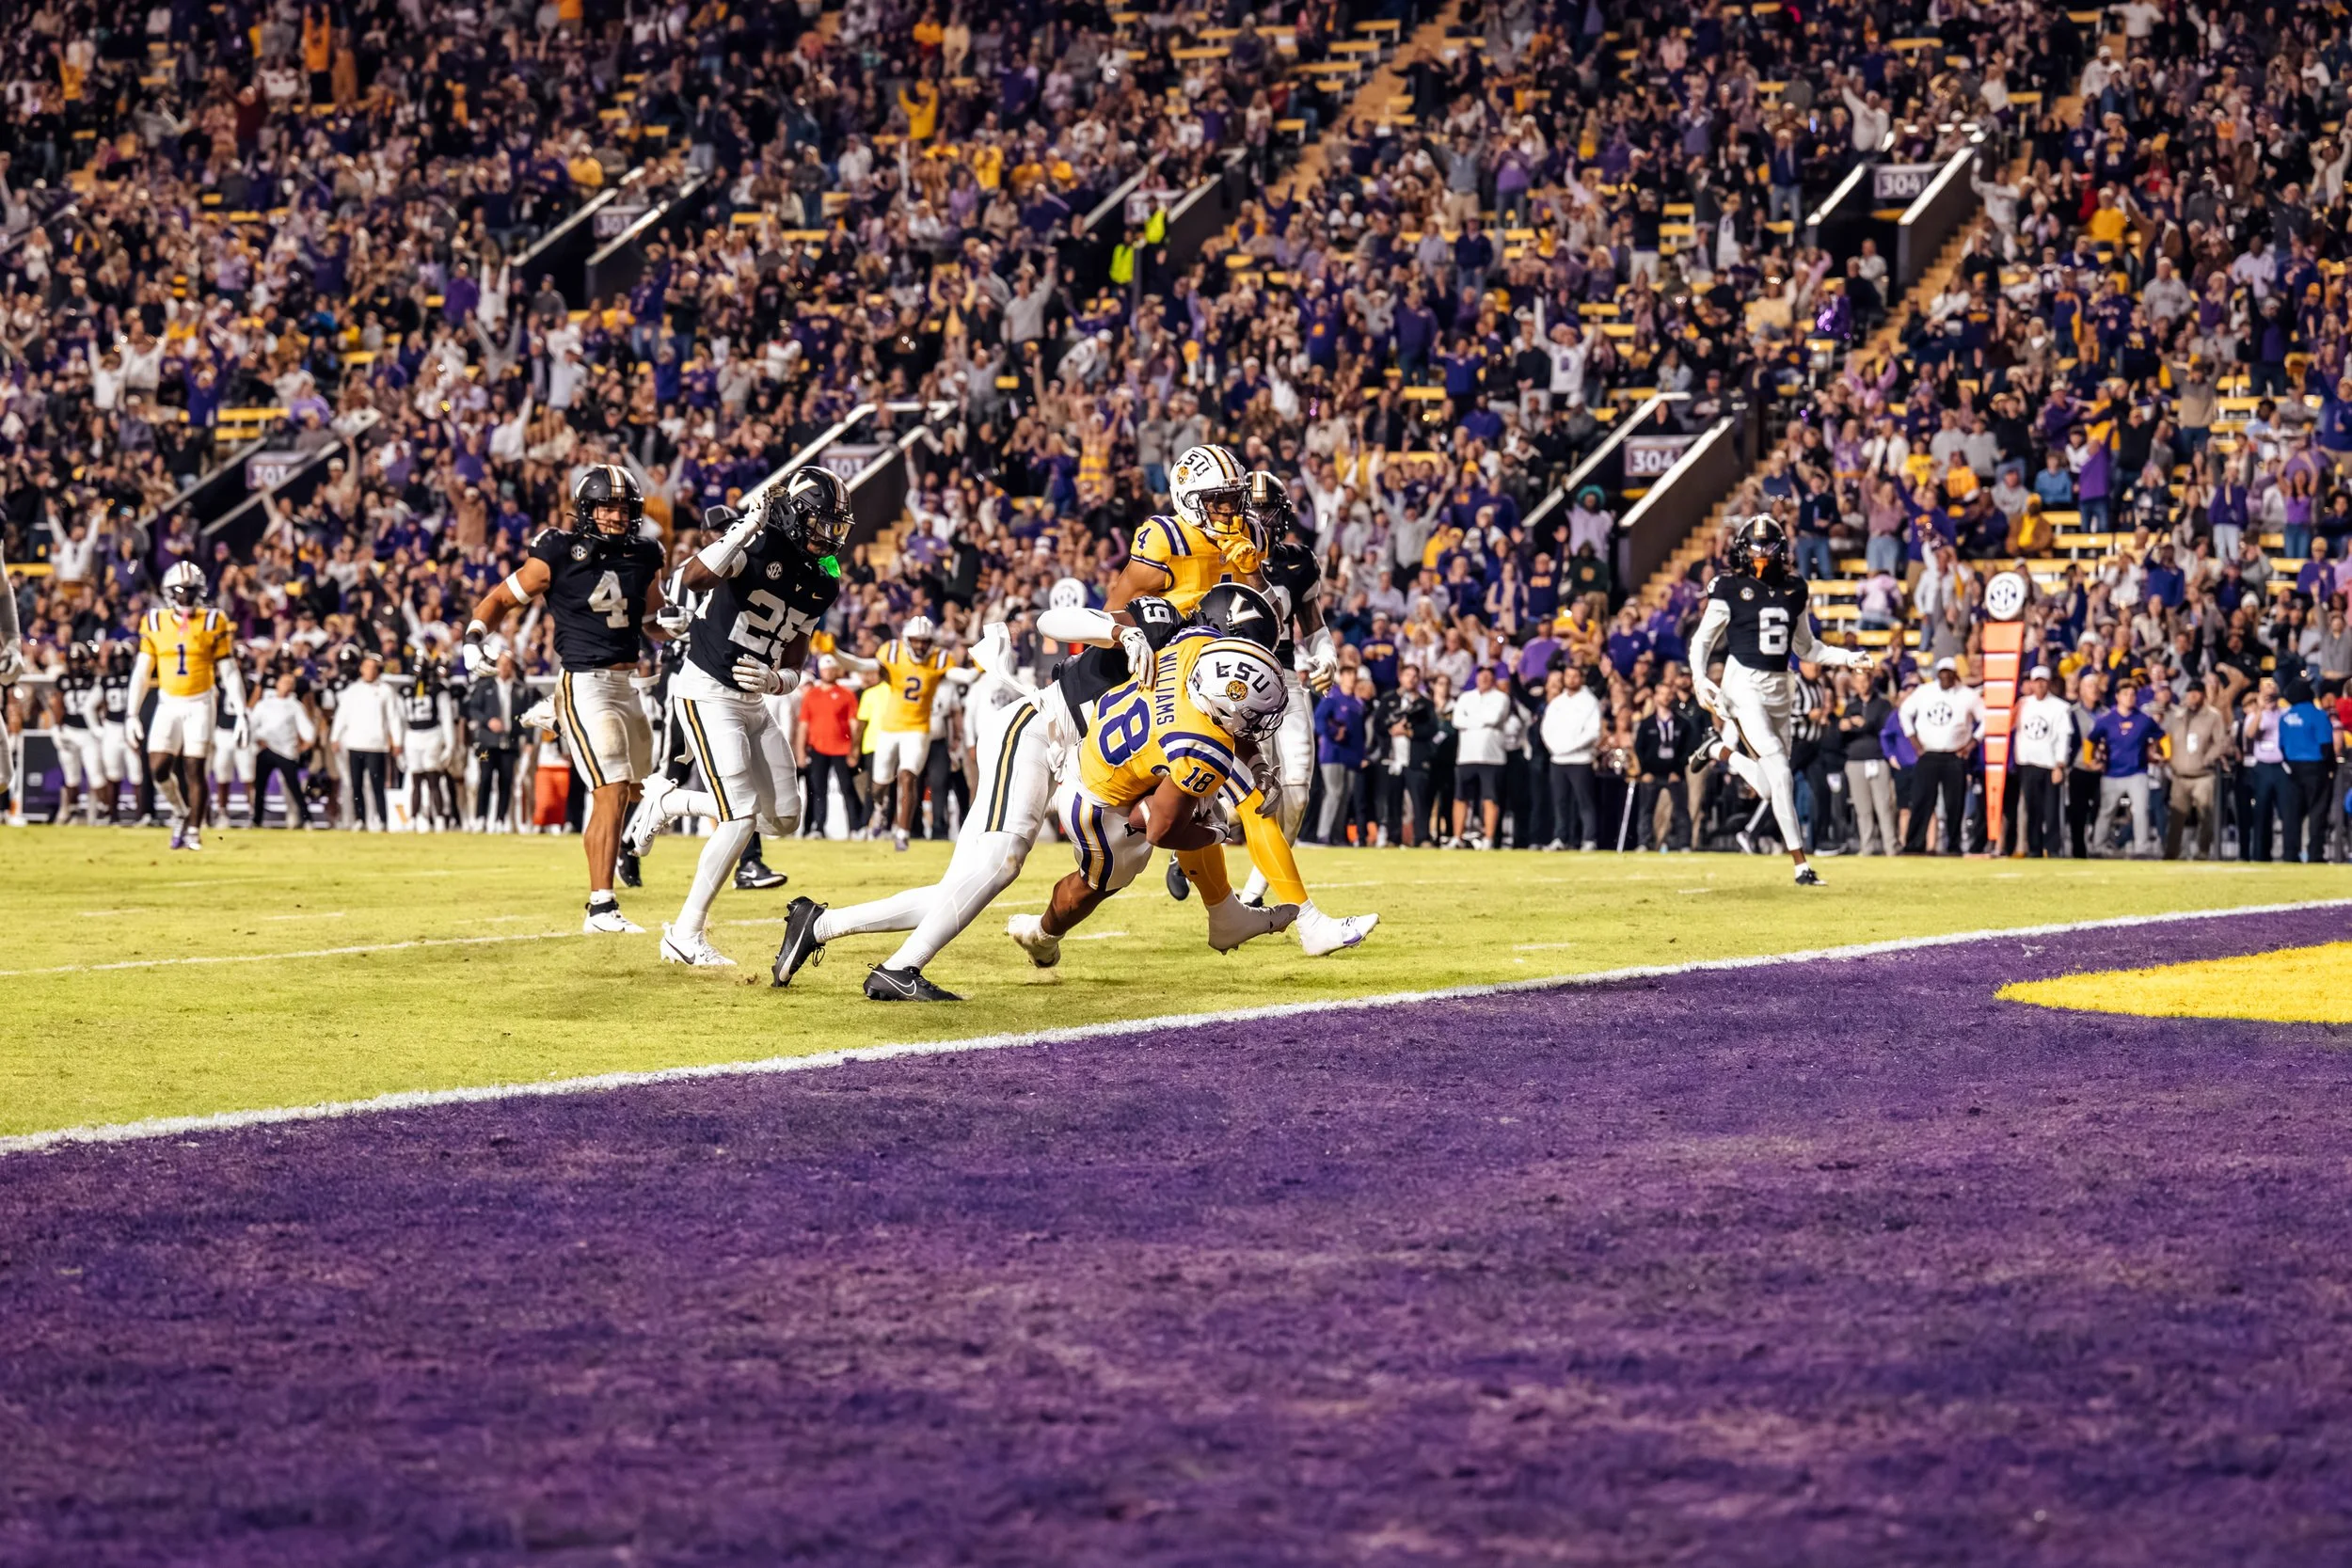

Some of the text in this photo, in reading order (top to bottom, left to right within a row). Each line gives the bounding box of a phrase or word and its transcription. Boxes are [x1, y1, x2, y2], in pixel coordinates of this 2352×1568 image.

[1882, 173, 1921, 196] 304
[1137, 527, 1152, 550] 4
[766, 562, 783, 579] SEC
[587, 569, 629, 629] 4
[1139, 596, 1171, 624] 19
[1229, 592, 1264, 625] V
[728, 589, 811, 662] 25
[1758, 607, 1789, 656] 6
[176, 642, 188, 676] 1
[904, 675, 921, 703] 2
[1154, 651, 1178, 727] WILLIAMS
[1216, 661, 1271, 694] LSU
[405, 694, 433, 721] 12
[1098, 679, 1151, 768] 18
[1181, 765, 1217, 794] 18
